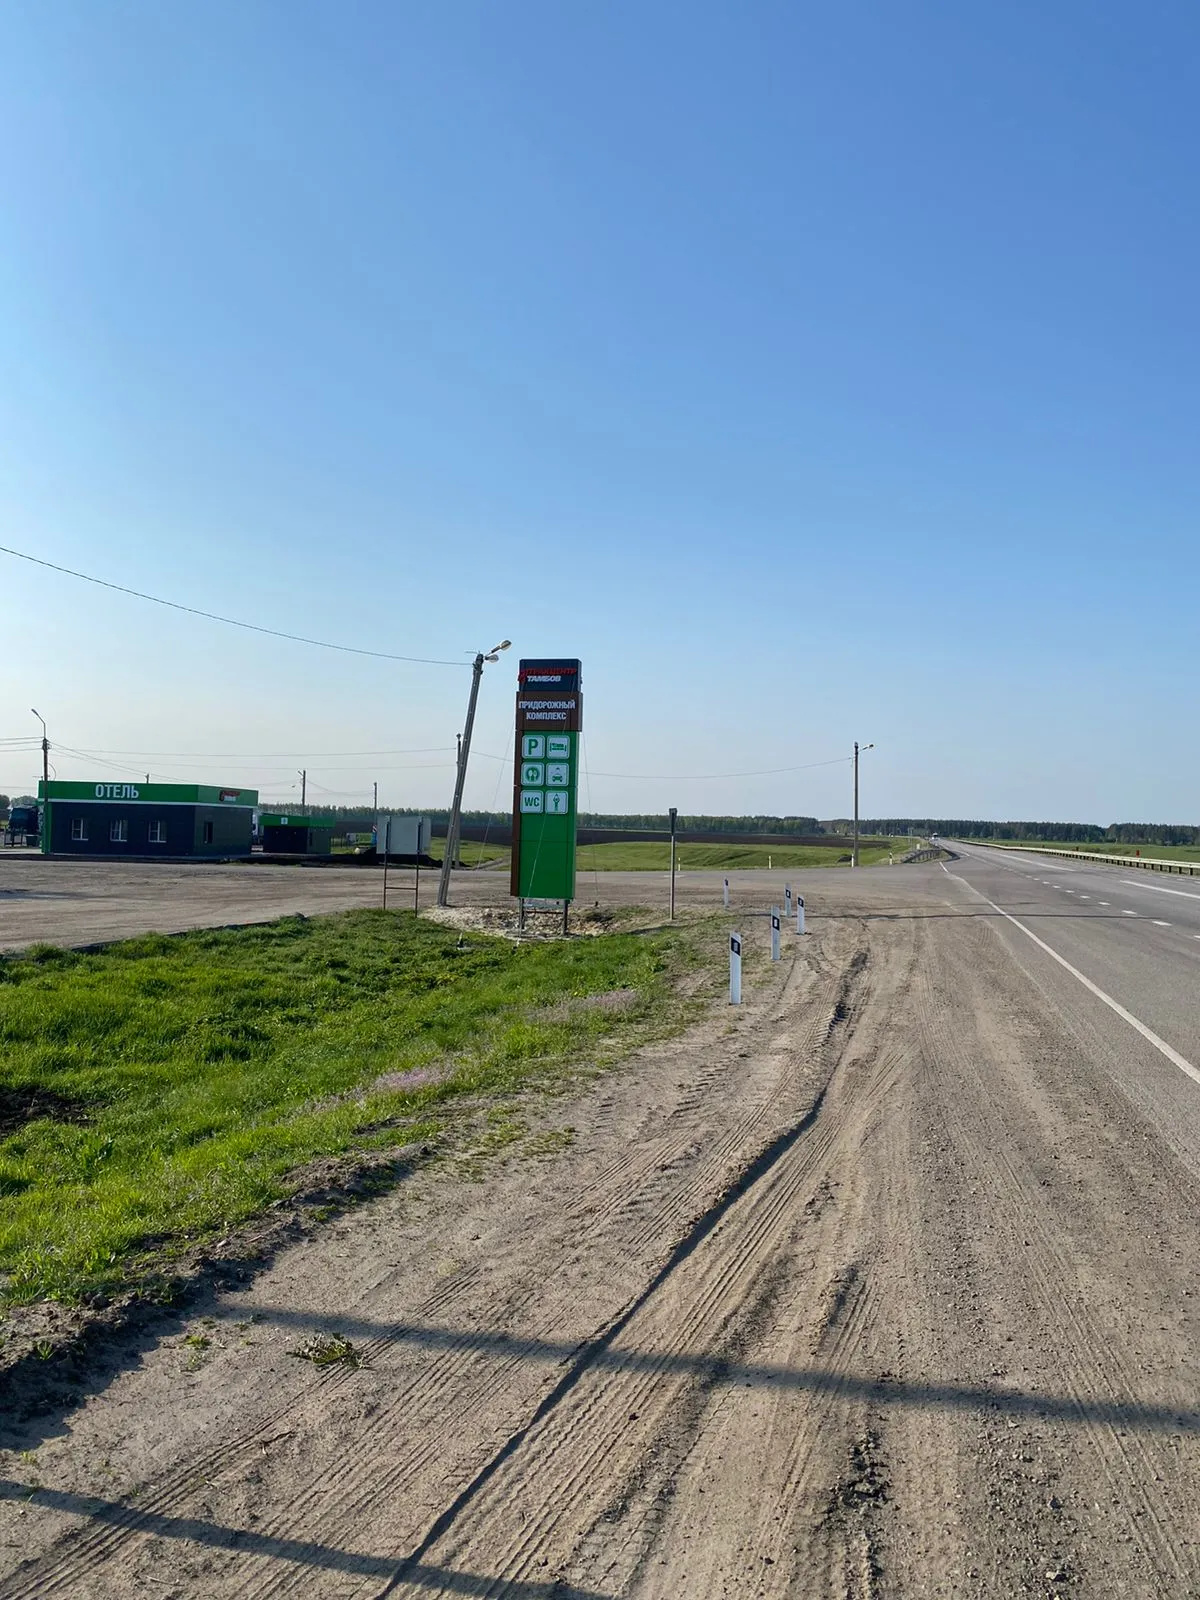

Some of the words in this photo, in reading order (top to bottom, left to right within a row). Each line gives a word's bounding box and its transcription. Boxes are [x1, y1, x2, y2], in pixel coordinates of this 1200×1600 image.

[518, 700, 576, 710] ПРИДОРОЖНЫЙ
[526, 712, 567, 720] КОМПЛЕКС
[95, 784, 139, 799] ОТЕЛЬ
[524, 797, 540, 807] WC
